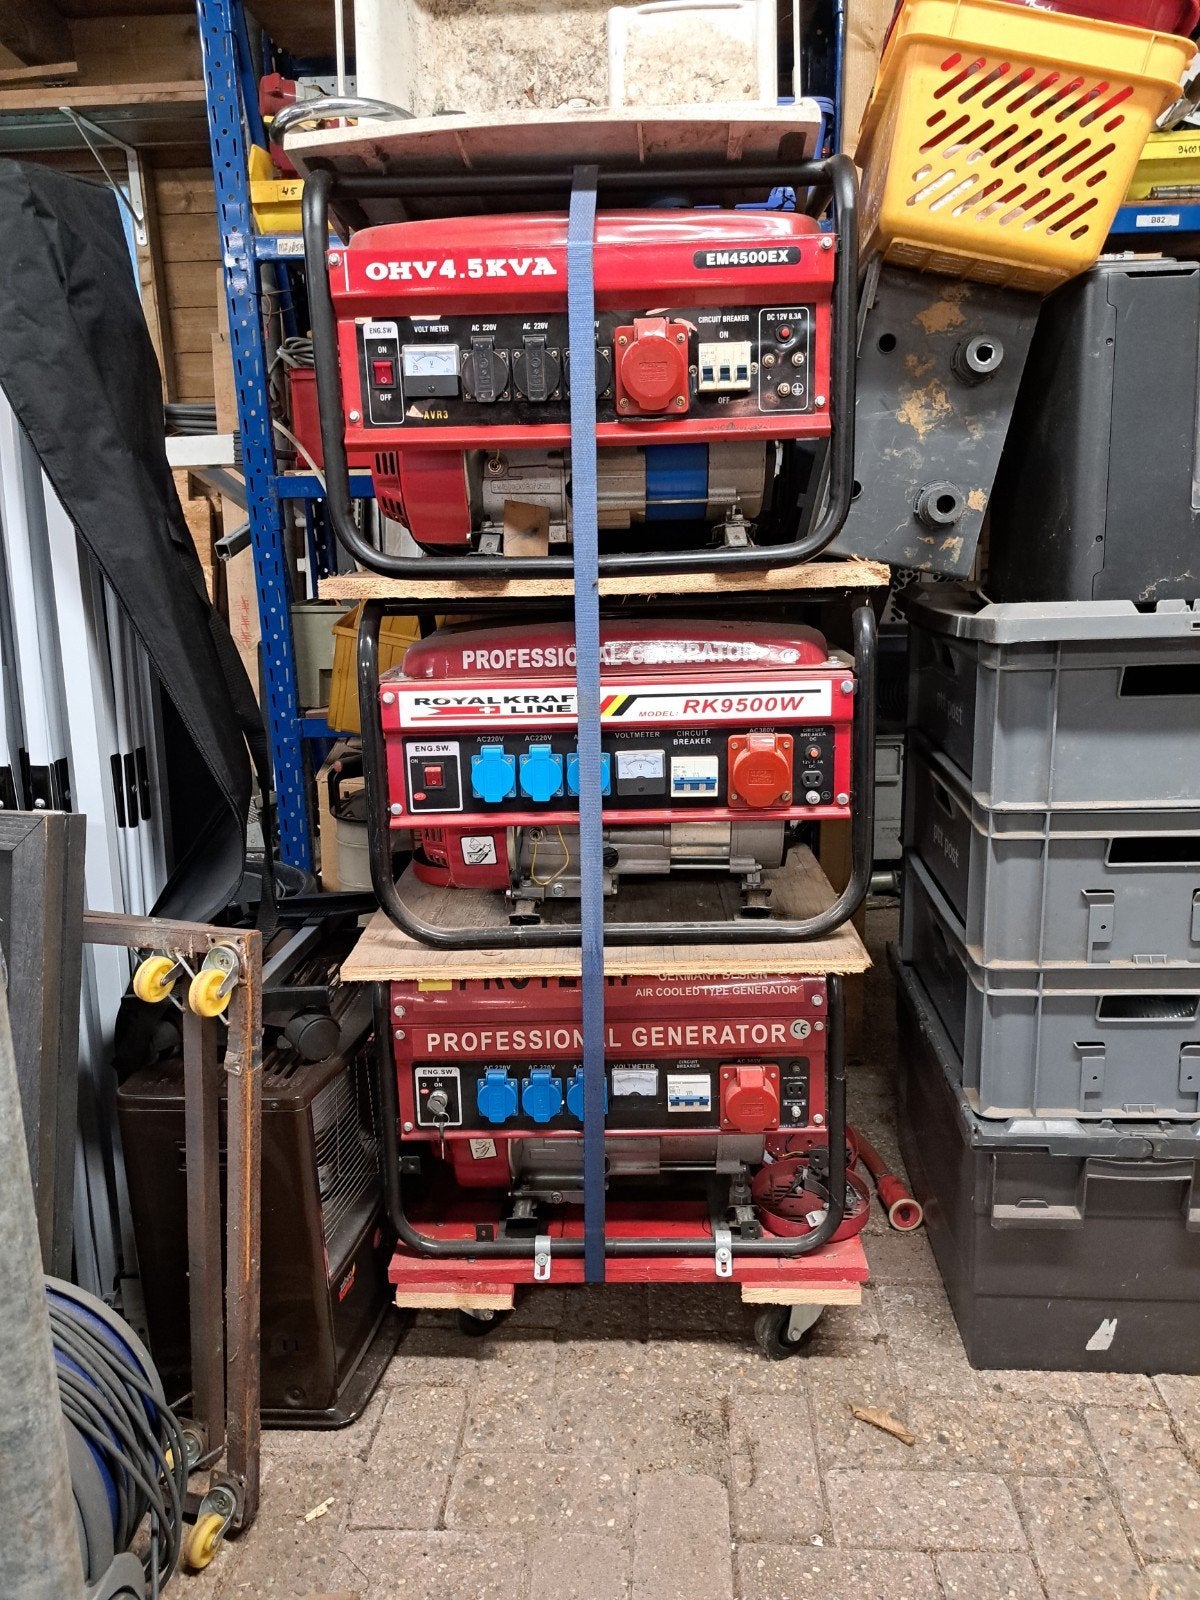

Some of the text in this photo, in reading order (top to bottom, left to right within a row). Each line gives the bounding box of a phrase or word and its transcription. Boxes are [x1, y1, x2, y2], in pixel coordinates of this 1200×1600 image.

[282, 187, 297, 195] 45
[706, 249, 789, 266] EM4500EX
[365, 257, 558, 280] OHV4.5KVA
[698, 314, 749, 324] CIRCUIT BREAKER
[789, 312, 802, 320] 8.3A
[482, 323, 497, 331] 220V
[522, 322, 531, 330] AC
[369, 327, 392, 335] ENG.SW
[719, 331, 729, 339] ON
[377, 346, 387, 354] ON
[380, 394, 392, 402] OFF
[718, 396, 730, 405] OFF
[424, 410, 449, 420] AVR3
[462, 645, 622, 670] PROFESSIOAL
[414, 694, 577, 706] ROYALKRAF
[511, 704, 571, 714] LINE
[683, 696, 804, 714] RK9500W
[615, 731, 660, 739] VOLTMETER
[676, 729, 709, 737] CIRCUIT
[525, 734, 552, 742] AC220V
[673, 737, 712, 746] BREAKER
[635, 985, 797, 997] AIR COOLED TYPE GENERATOR
[427, 1024, 786, 1052] PROFESSIONL GENERATOR
